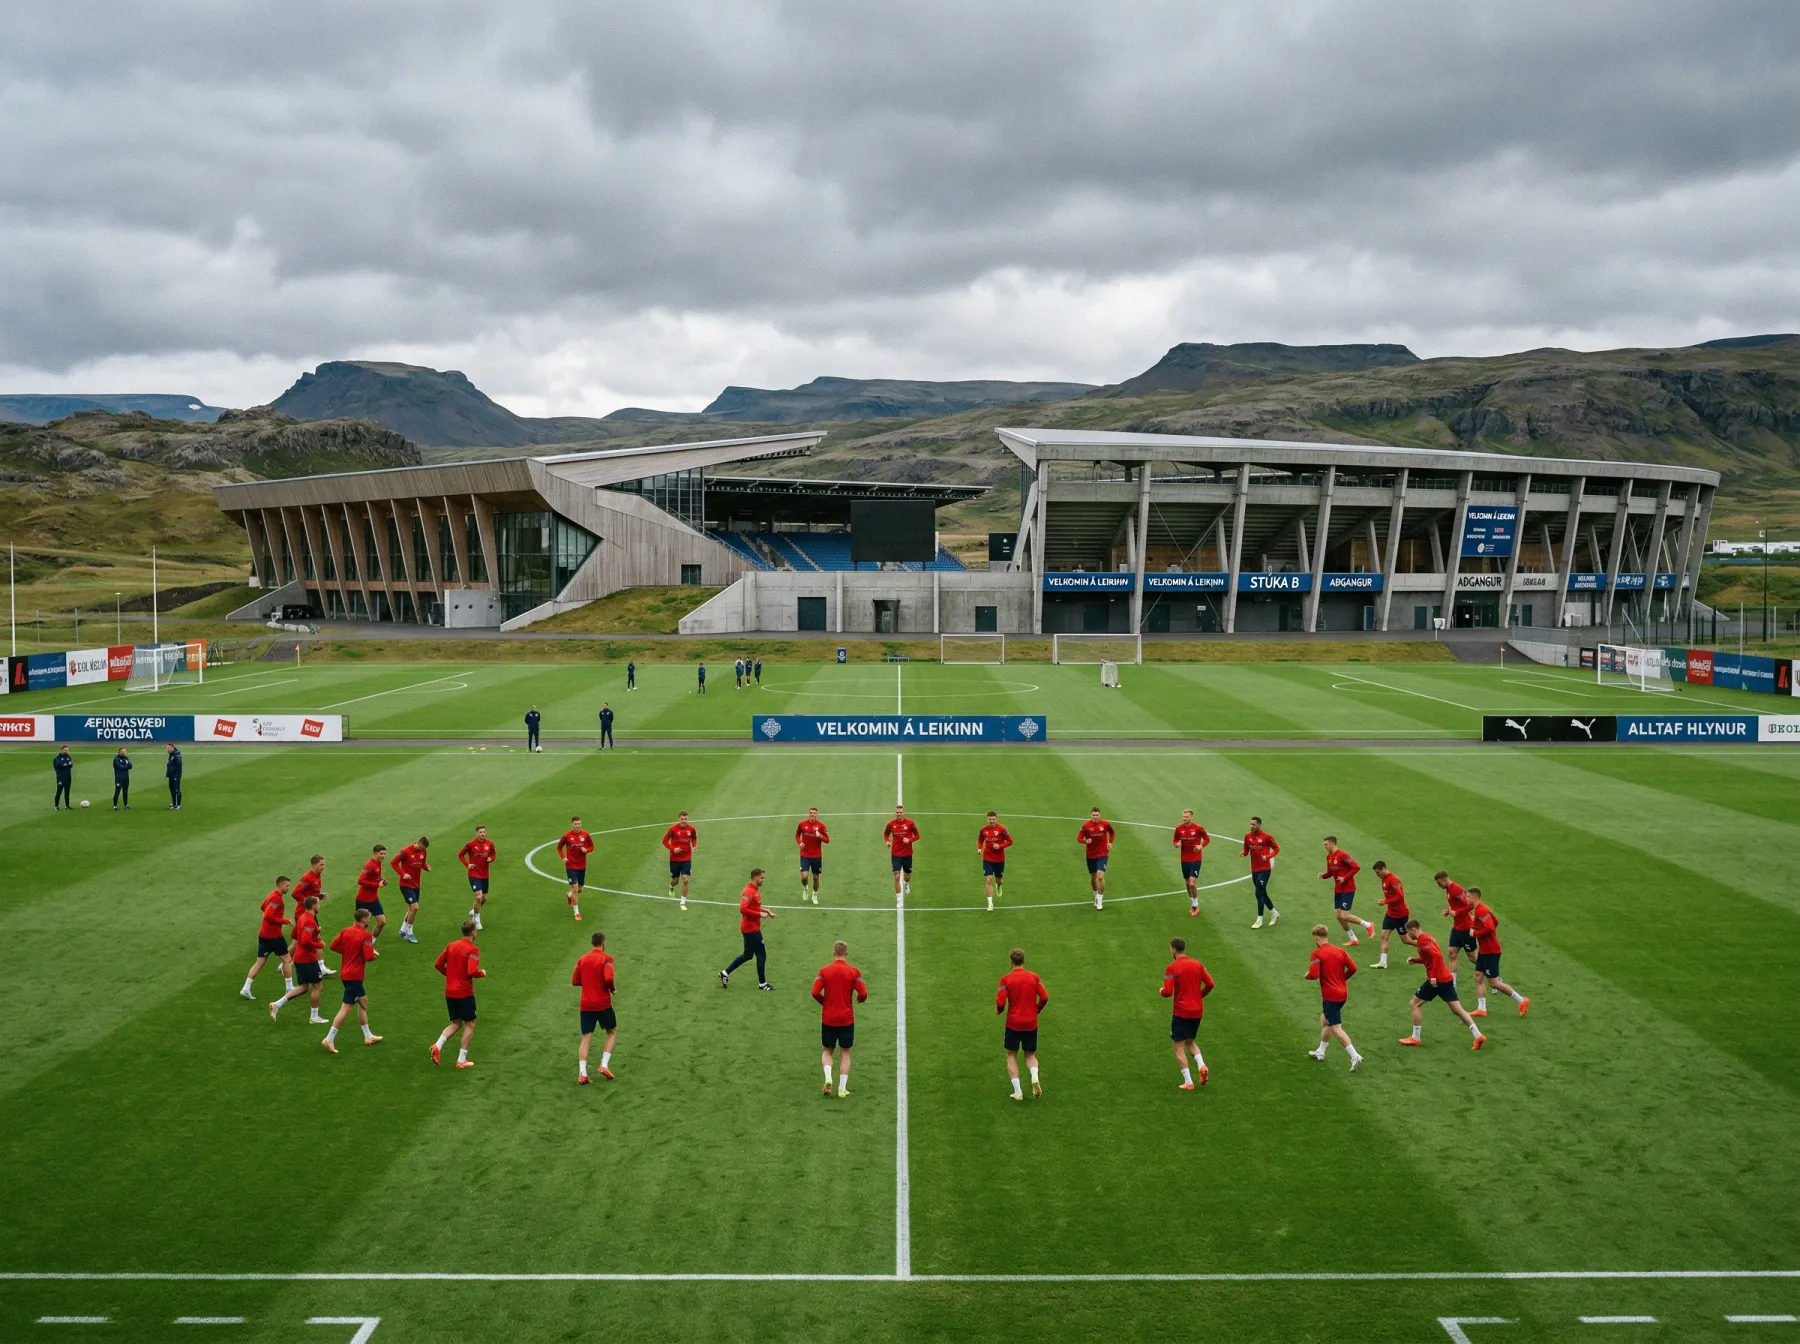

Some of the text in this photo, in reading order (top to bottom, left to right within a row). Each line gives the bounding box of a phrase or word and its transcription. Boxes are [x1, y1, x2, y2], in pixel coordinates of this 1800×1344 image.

[1148, 578, 1186, 586] VELKOMIN
[1188, 576, 1194, 586] Á
[1292, 577, 1300, 588] B
[817, 718, 983, 736] VELKOMIN Á LEIKINN
[1628, 722, 1747, 735] ALLTAF HLYNUR
